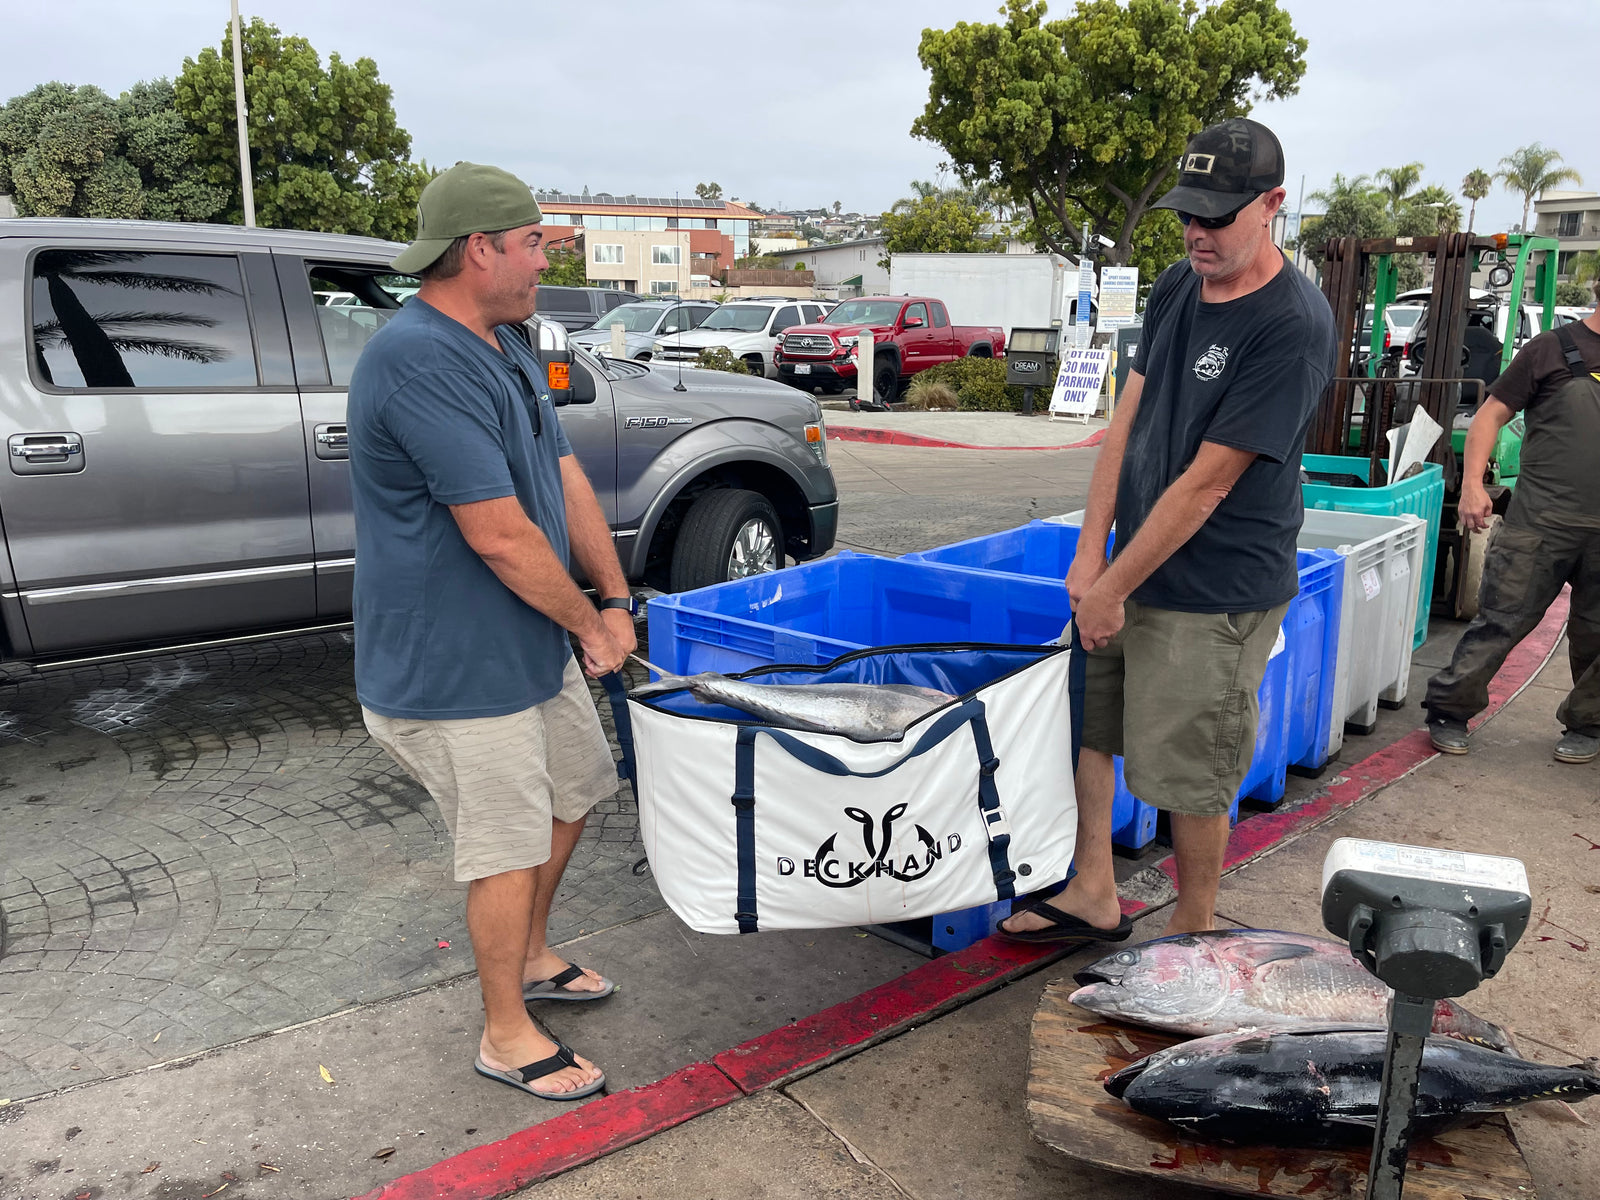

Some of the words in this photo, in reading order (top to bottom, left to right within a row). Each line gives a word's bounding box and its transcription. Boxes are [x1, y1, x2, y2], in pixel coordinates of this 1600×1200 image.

[1084, 351, 1105, 360] FULL
[1014, 361, 1038, 372] DREAM
[1063, 361, 1078, 373] 30
[1078, 362, 1100, 375] MIN.
[1057, 375, 1100, 389] PARKING
[1063, 389, 1088, 403] ONLY
[777, 832, 962, 879] DECKHAND
